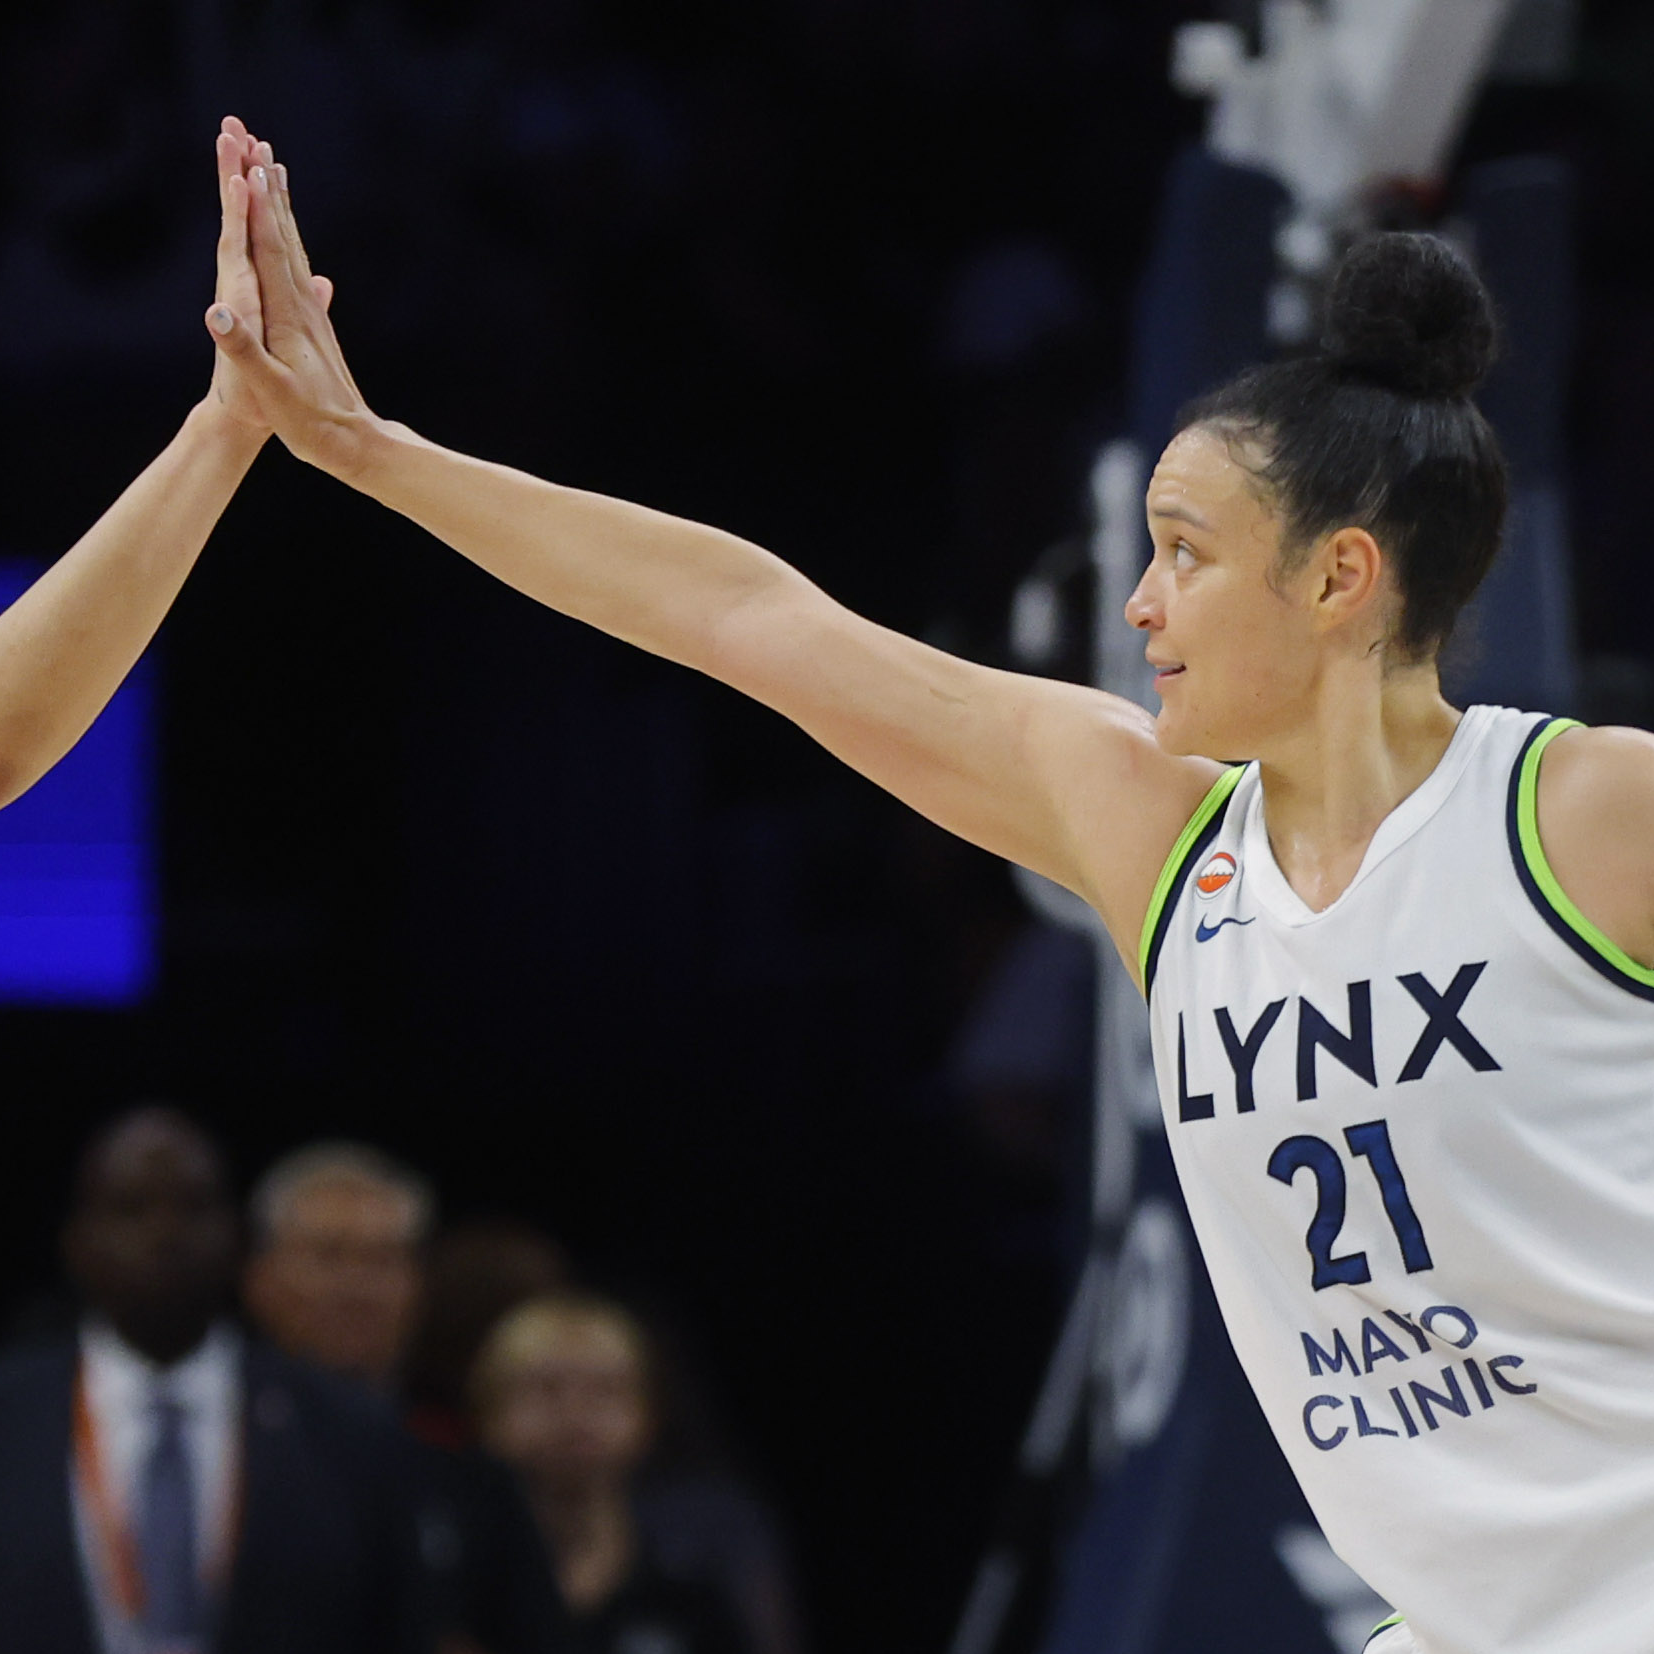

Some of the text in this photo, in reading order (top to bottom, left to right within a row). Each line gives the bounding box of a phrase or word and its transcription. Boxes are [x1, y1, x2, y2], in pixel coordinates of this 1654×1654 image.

[1177, 959, 1503, 1124] LYNX
[1266, 1118, 1434, 1292] 21
[1299, 1304, 1478, 1378] MAYO
[1302, 1354, 1538, 1452] CLINIC
